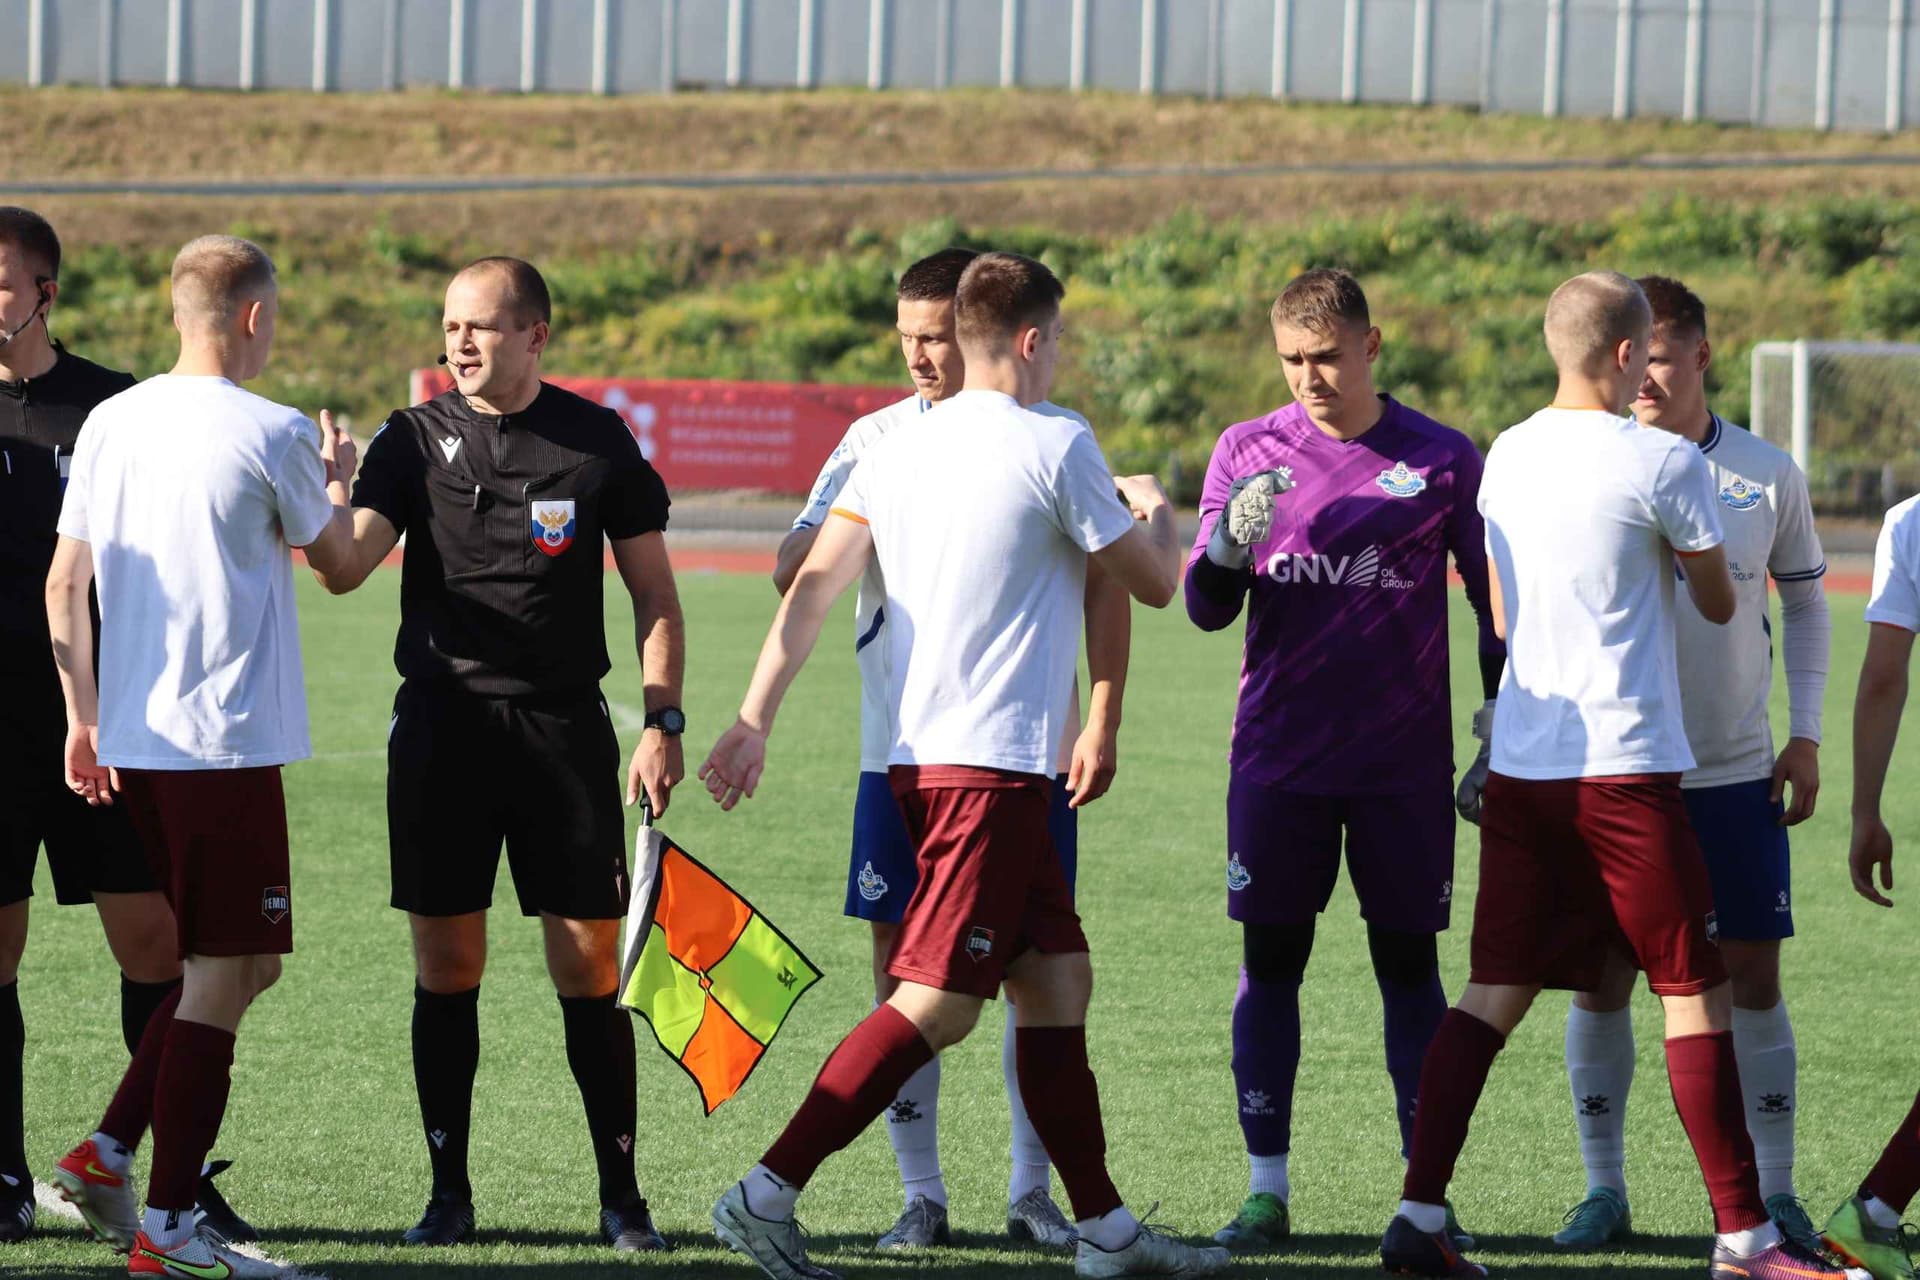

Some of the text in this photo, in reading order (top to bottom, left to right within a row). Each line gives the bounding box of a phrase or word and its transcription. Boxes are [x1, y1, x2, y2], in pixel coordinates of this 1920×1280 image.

[1267, 552, 1350, 584] GNV
[1380, 568, 1397, 578] OIL
[1380, 579, 1415, 589] GROUP
